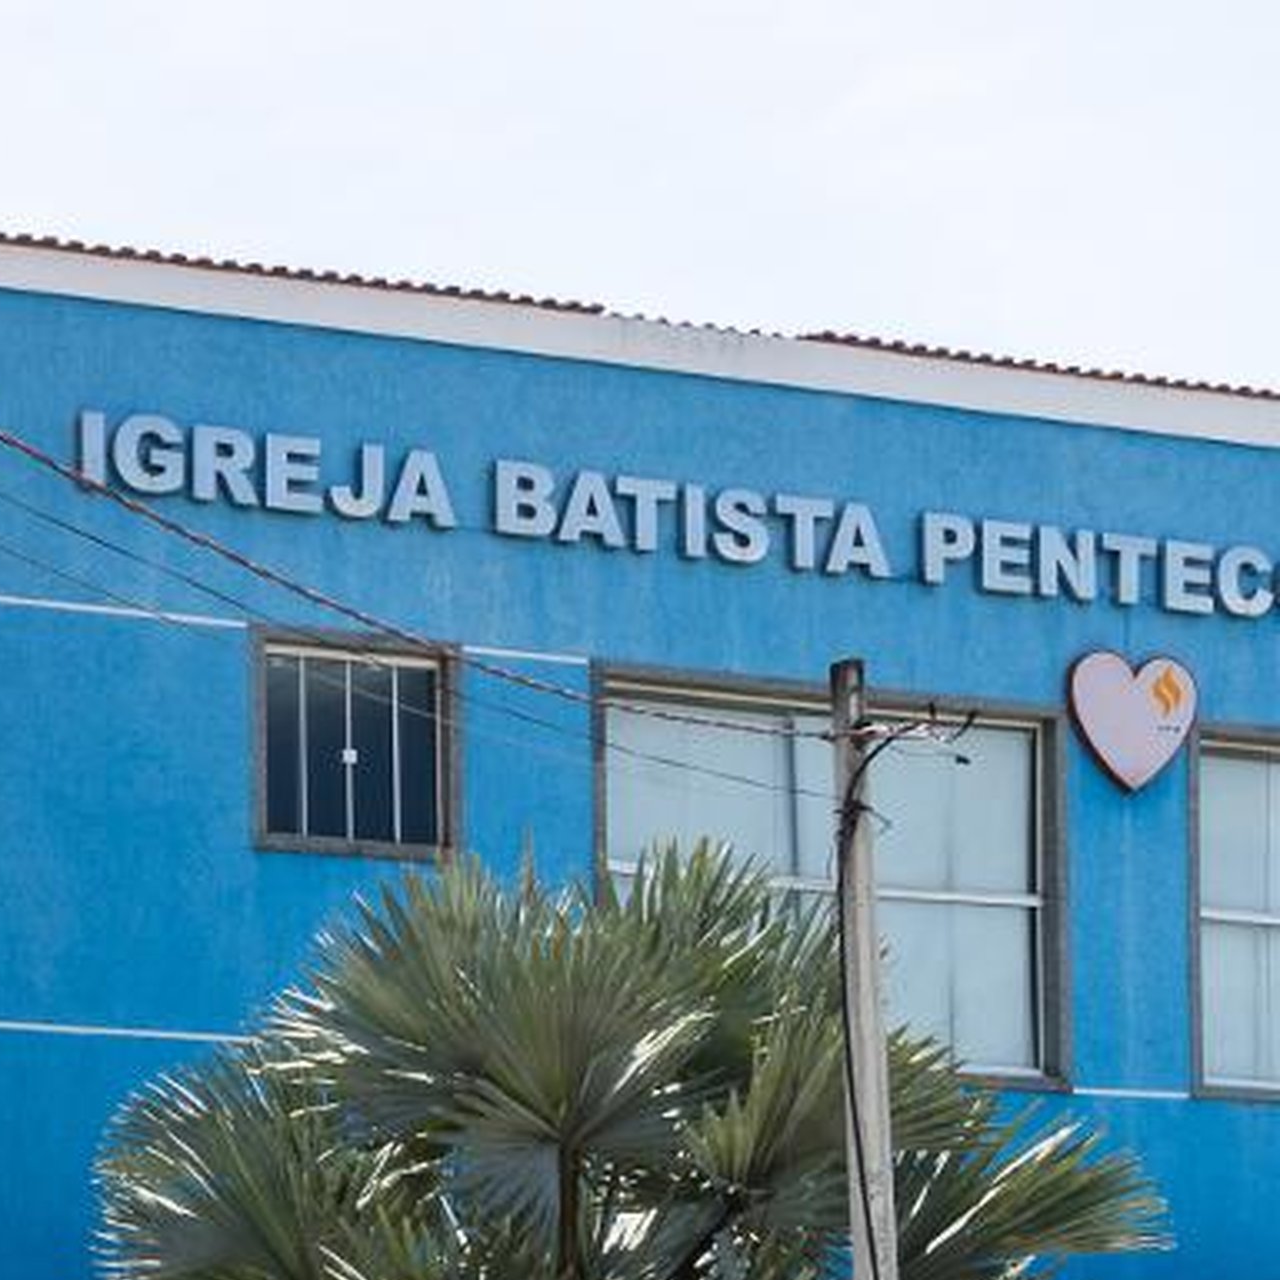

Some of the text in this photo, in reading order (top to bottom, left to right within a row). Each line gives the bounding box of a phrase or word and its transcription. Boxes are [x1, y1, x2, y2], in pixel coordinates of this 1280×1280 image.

[80, 409, 1275, 618] IGREJA BATISTA PENTEC
